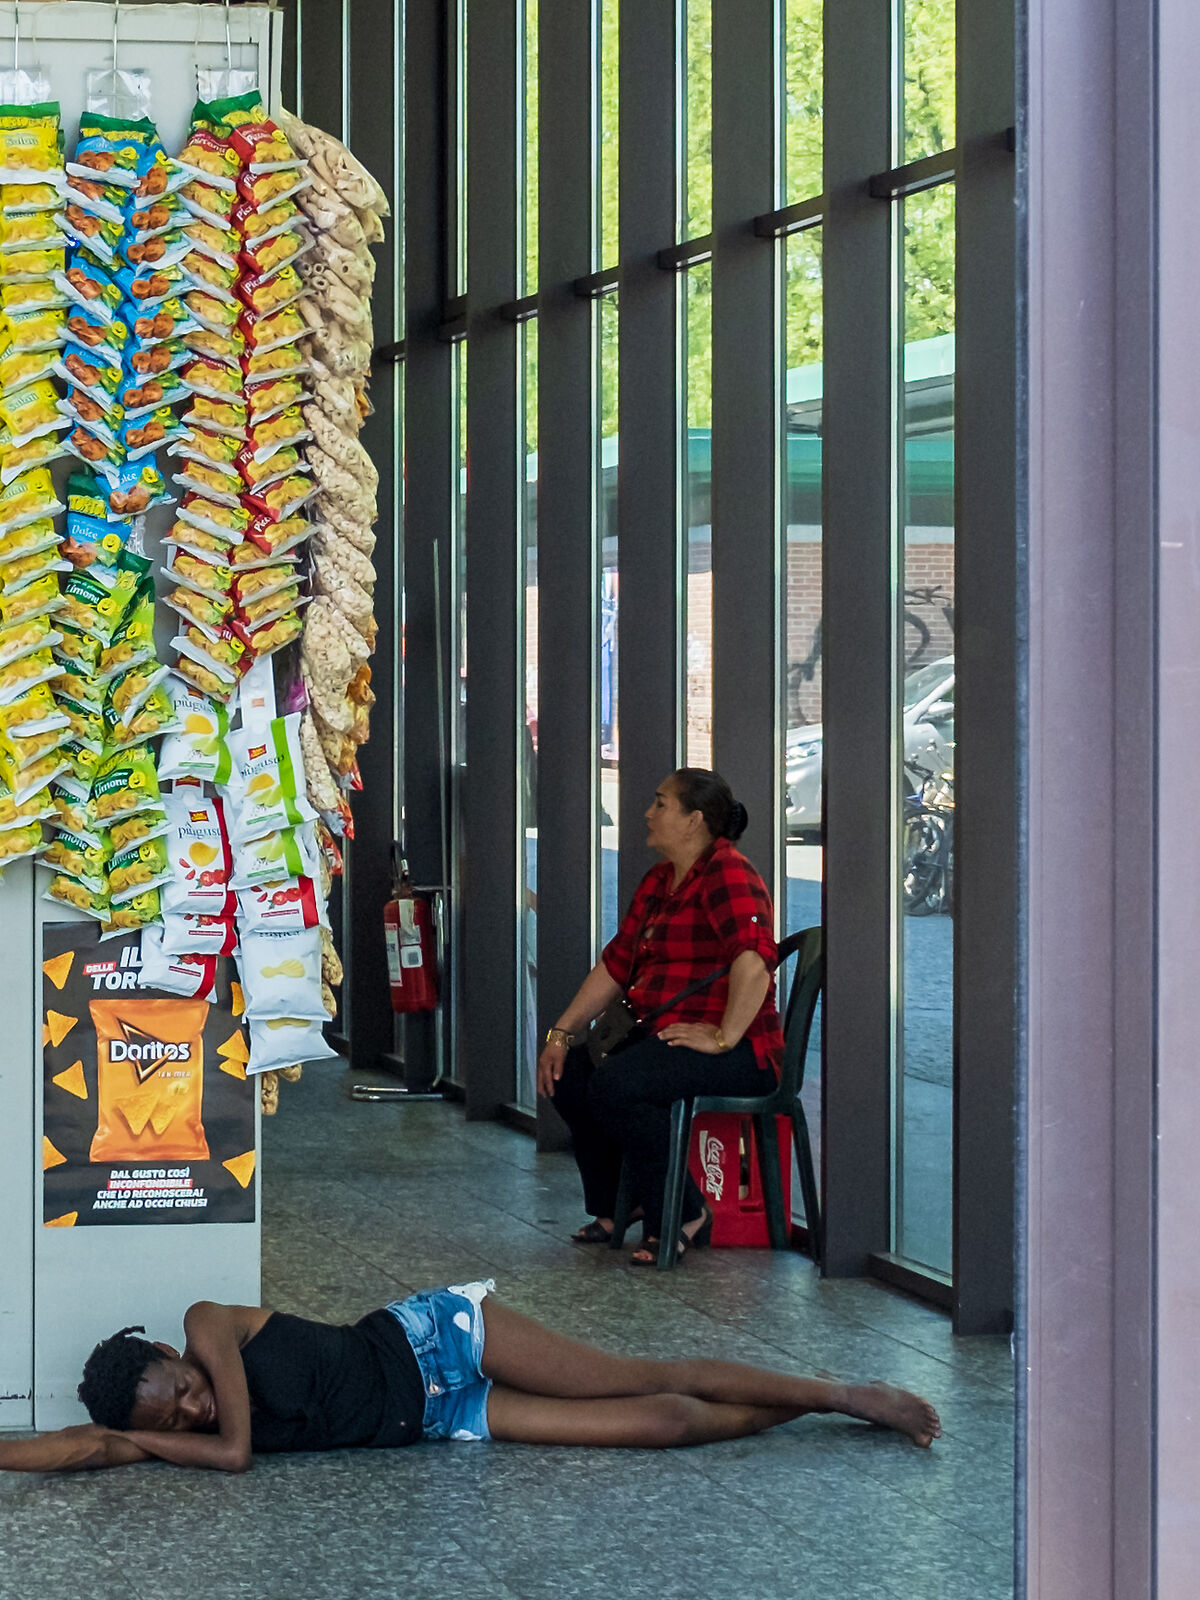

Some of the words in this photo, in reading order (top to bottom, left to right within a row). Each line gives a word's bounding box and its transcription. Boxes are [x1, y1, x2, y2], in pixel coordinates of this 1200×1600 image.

[72, 524, 99, 540] Dolce
[94, 777, 128, 797] Limone
[107, 850, 140, 871] Limone
[120, 946, 142, 968] IL
[86, 963, 114, 973] DELLE
[91, 972, 143, 990] TOR
[110, 1041, 191, 1062] Doritos
[110, 1170, 131, 1179] DAL
[132, 1169, 166, 1179] GUSTO
[167, 1166, 190, 1178] COSÌ
[109, 1178, 191, 1189] INCONFONDIBILE
[97, 1190, 117, 1199] CHE
[118, 1190, 131, 1199] LO
[132, 1188, 204, 1198] RICONOSCERAI
[93, 1200, 127, 1209] ANCHE
[128, 1199, 143, 1209] AD
[144, 1199, 174, 1208] OCCHI
[175, 1198, 208, 1207] CHIUSI
